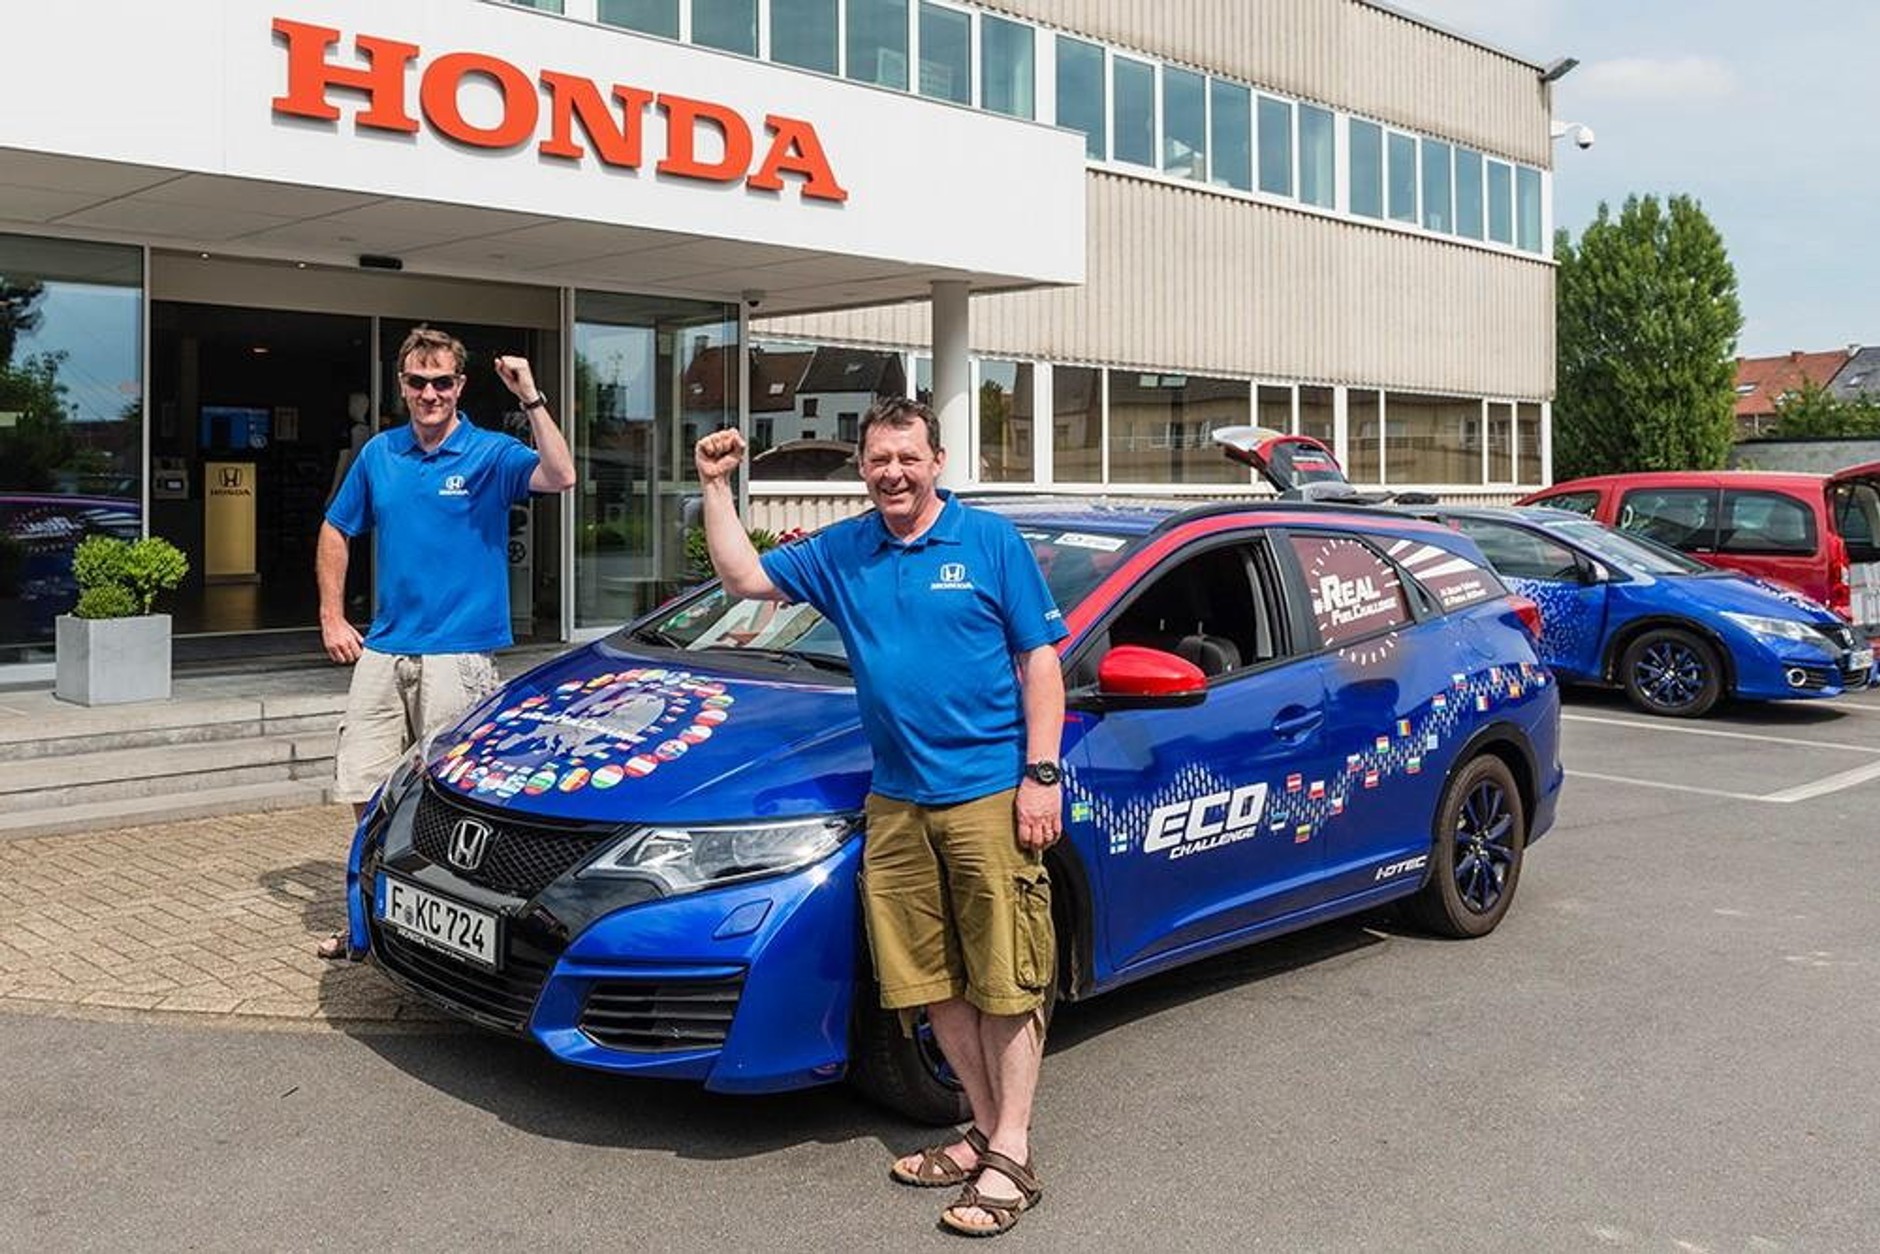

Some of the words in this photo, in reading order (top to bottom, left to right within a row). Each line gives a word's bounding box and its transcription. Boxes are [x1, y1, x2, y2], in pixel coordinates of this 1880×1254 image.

[272, 17, 848, 203] HONDA
[1143, 782, 1268, 853] ECO
[1169, 825, 1257, 859] CHALLENGE
[392, 885, 403, 918] F
